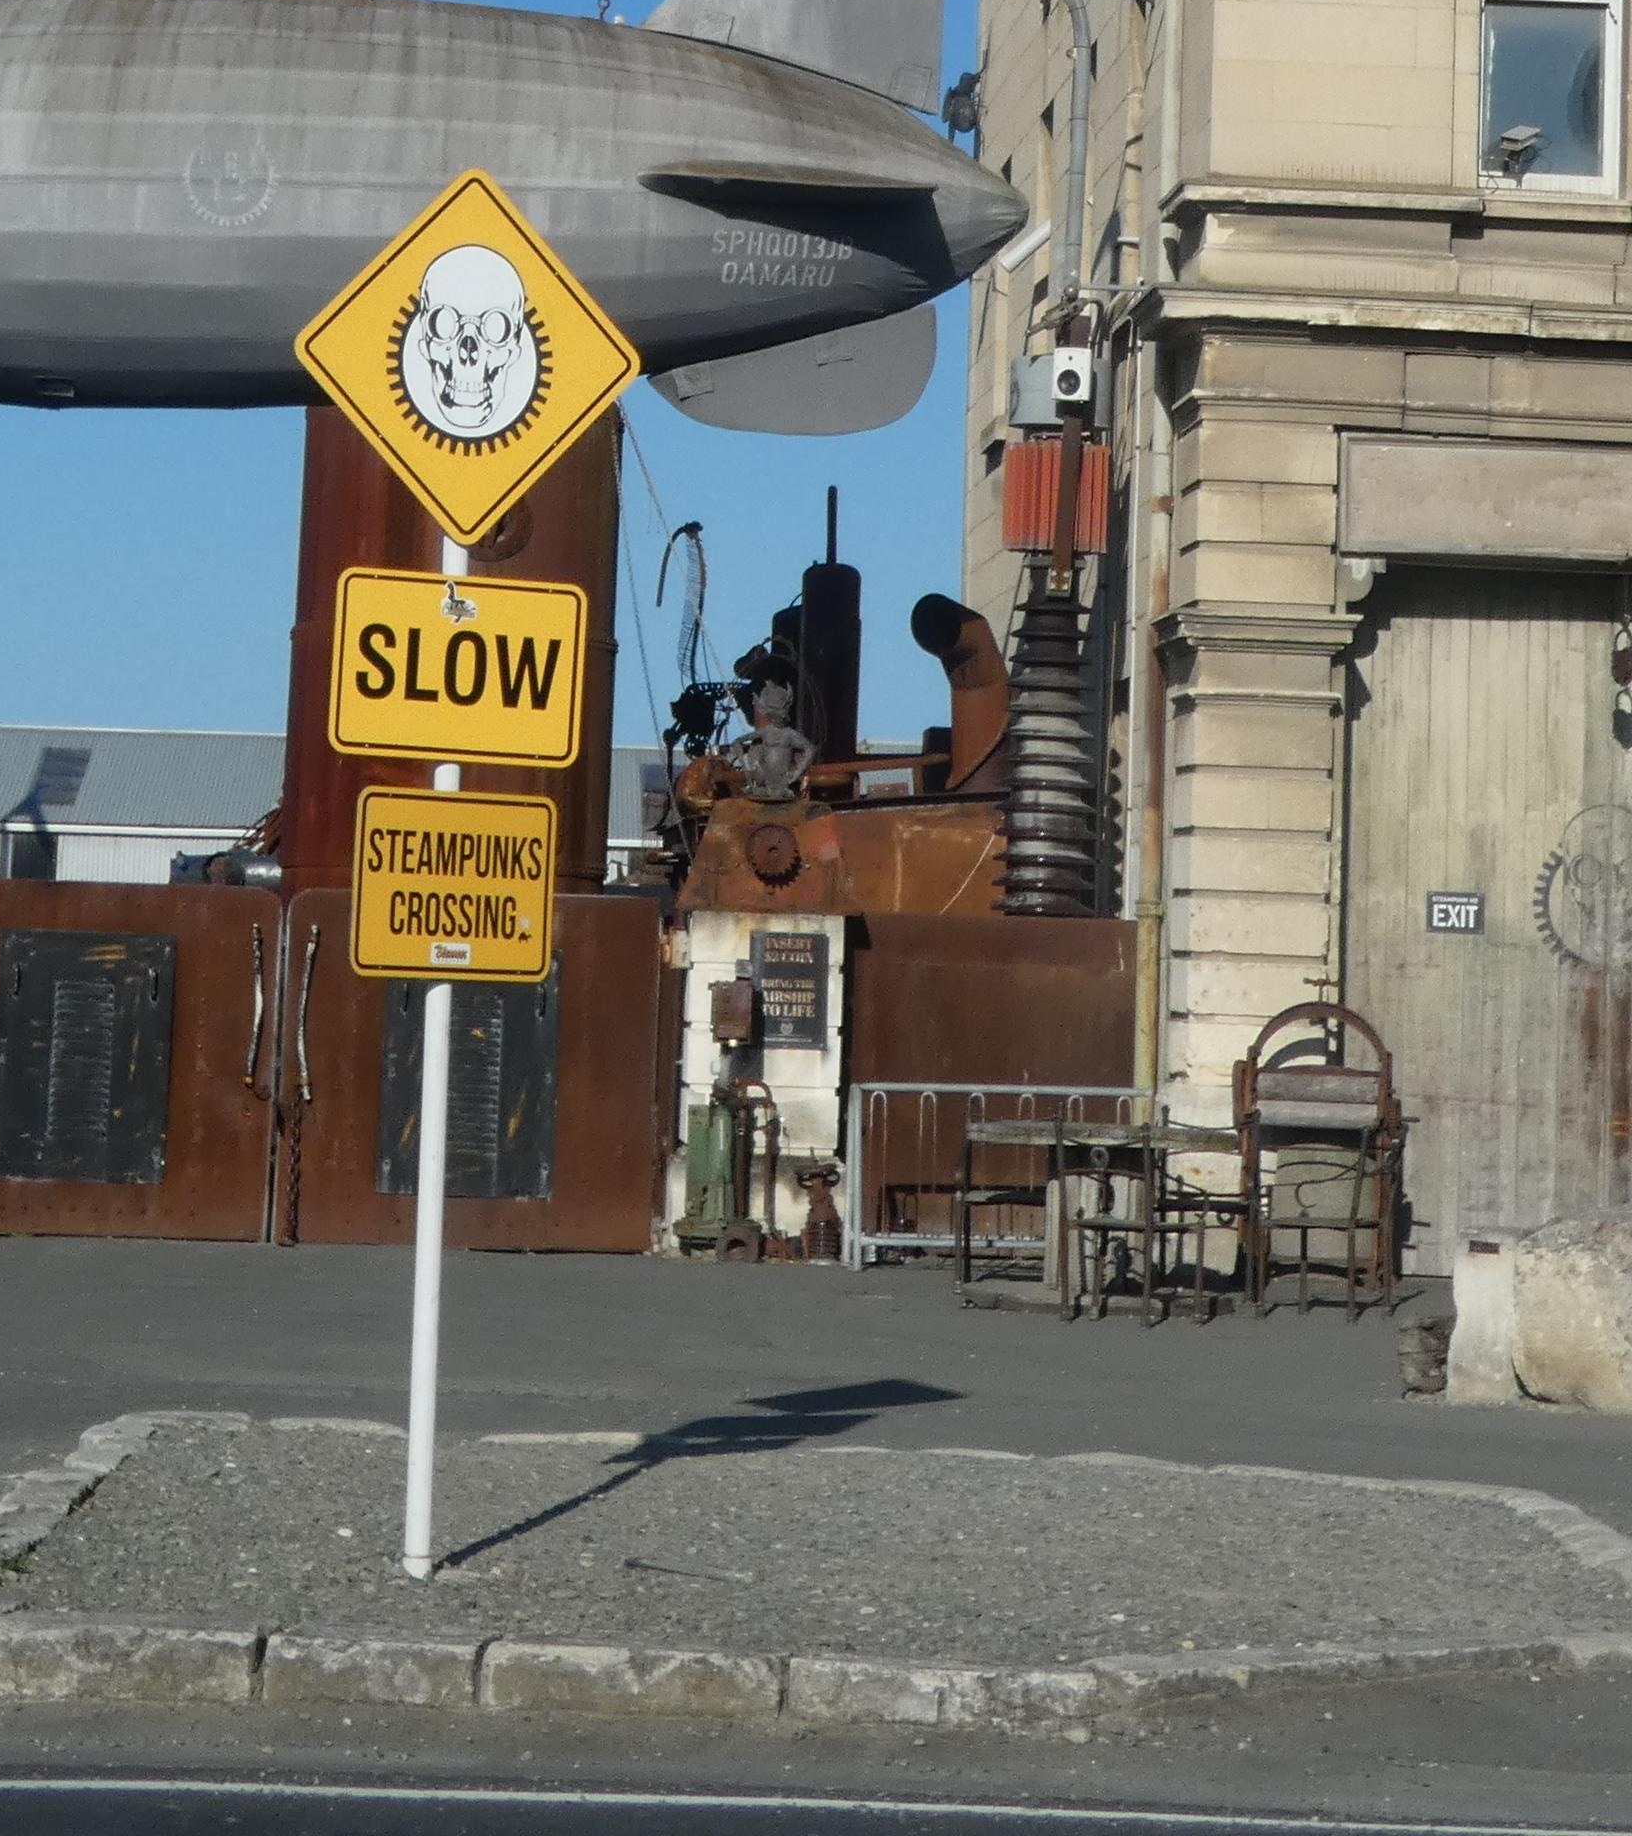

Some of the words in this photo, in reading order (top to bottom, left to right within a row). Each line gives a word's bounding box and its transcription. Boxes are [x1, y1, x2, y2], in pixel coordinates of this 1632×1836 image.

[720, 261, 836, 288] OAMARU
[355, 622, 562, 711] SLOW
[368, 827, 543, 881] STEAMPUNKS
[389, 890, 517, 940] CROSSING
[1432, 904, 1479, 929] EXIT
[765, 937, 813, 950] INSERT
[763, 990, 816, 1004] AIRSHIP
[763, 1003, 781, 1016] TO
[783, 1004, 815, 1017] LIFE
